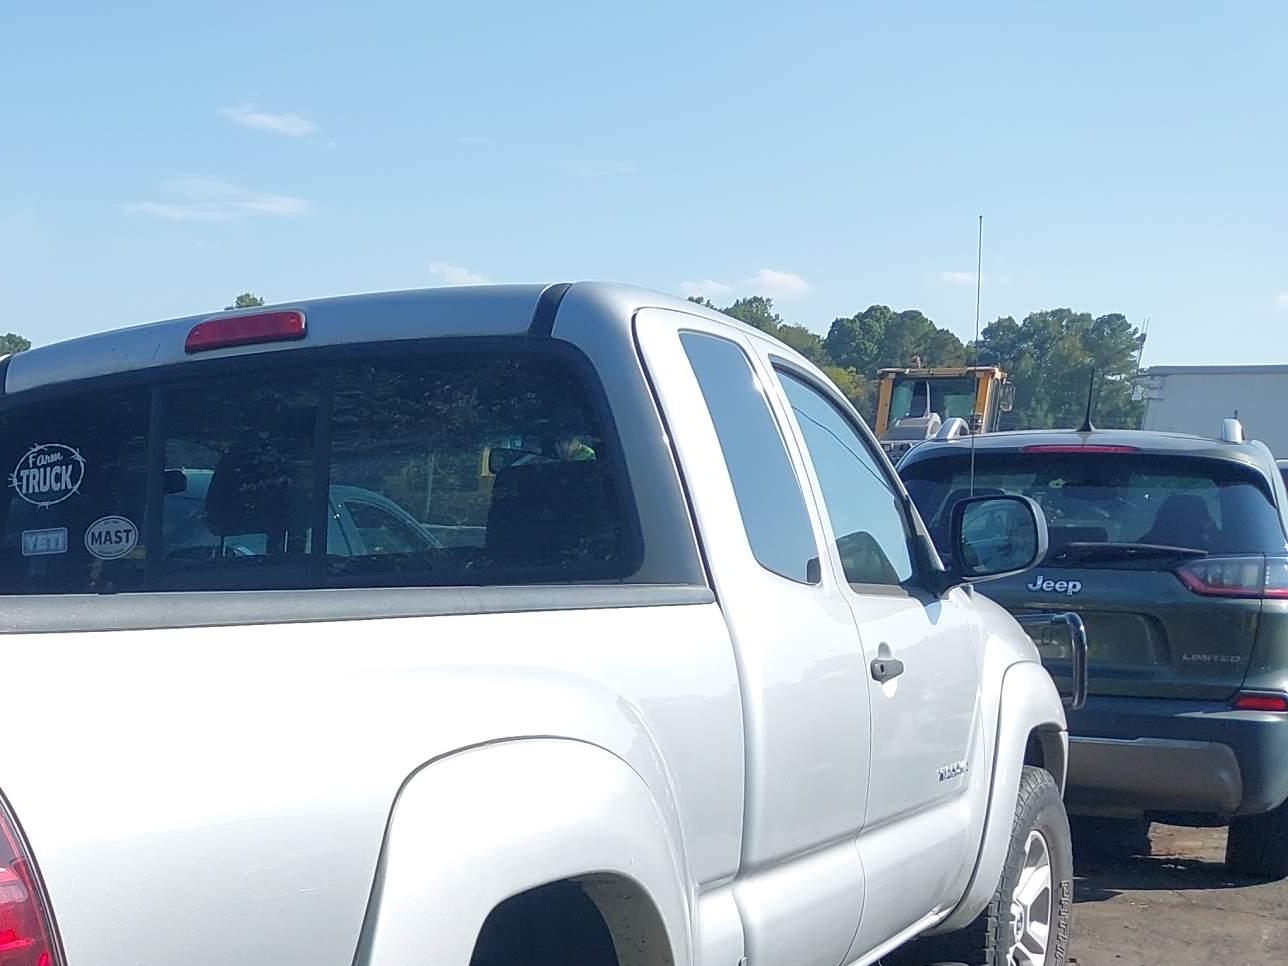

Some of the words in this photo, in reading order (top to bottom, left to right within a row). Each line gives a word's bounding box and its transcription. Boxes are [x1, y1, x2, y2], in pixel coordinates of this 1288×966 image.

[29, 452, 63, 467] Farm
[20, 464, 73, 494] TRUCK
[25, 534, 64, 552] YETI
[91, 529, 132, 546] MAST
[1028, 575, 1082, 596] Jeep
[1182, 652, 1241, 663] LIMITED
